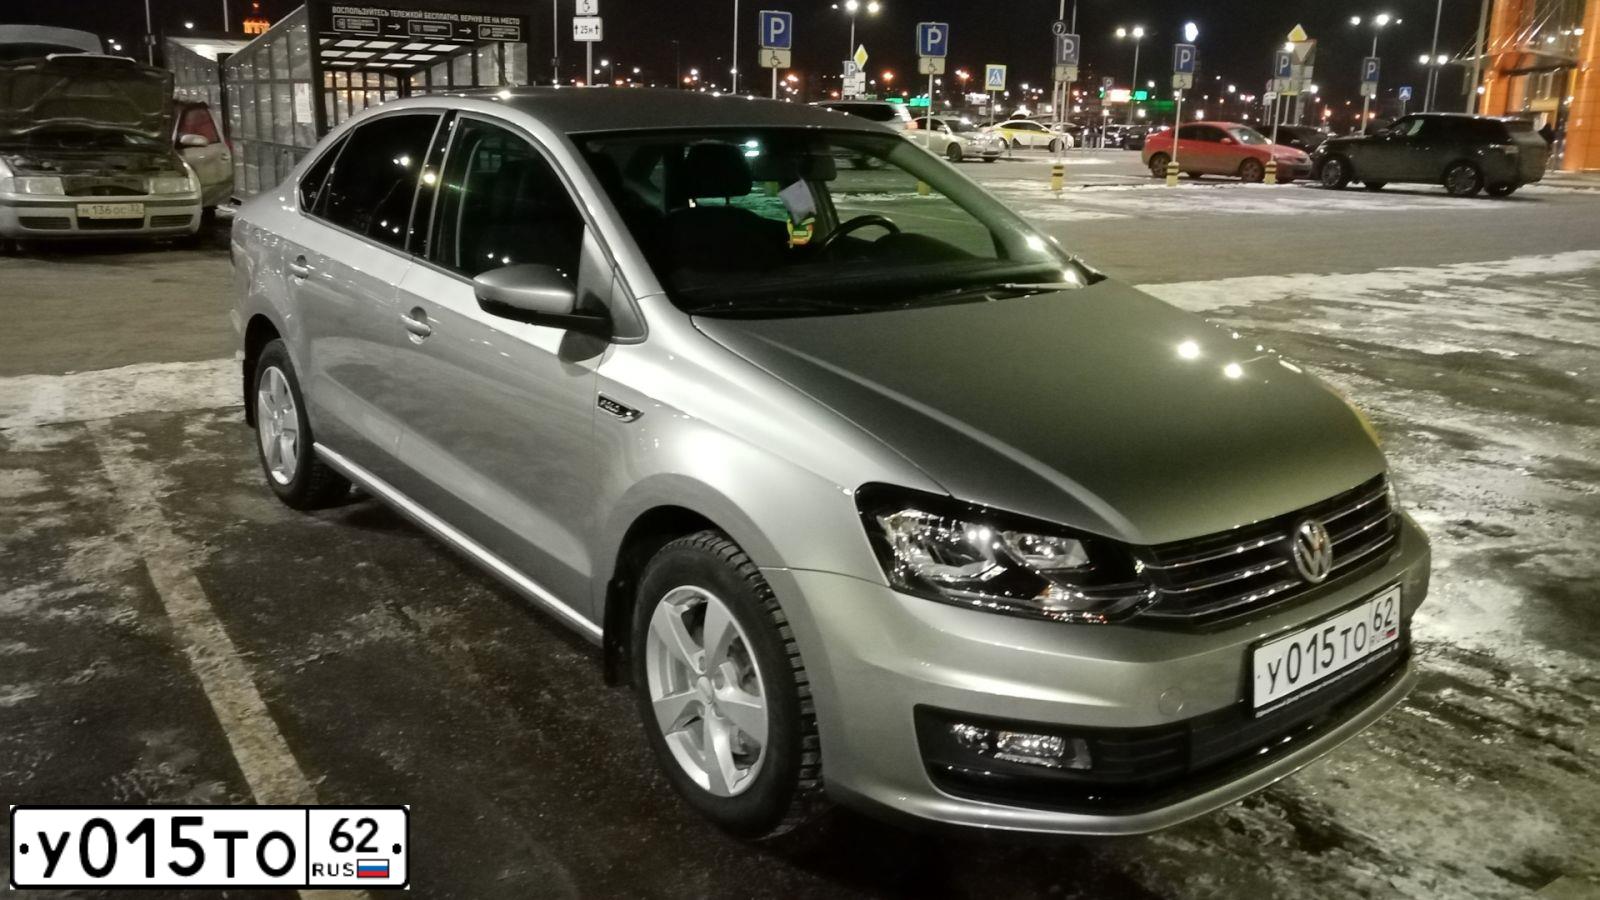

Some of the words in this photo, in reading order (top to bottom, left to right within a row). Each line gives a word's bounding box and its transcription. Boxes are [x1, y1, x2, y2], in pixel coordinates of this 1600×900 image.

[770, 17, 785, 42] P
[928, 27, 942, 52] P
[1063, 39, 1074, 61] P
[1179, 50, 1190, 69] P
[847, 63, 856, 75] P
[1279, 55, 1289, 74] P
[1367, 63, 1376, 80] P
[1373, 597, 1394, 631] 62
